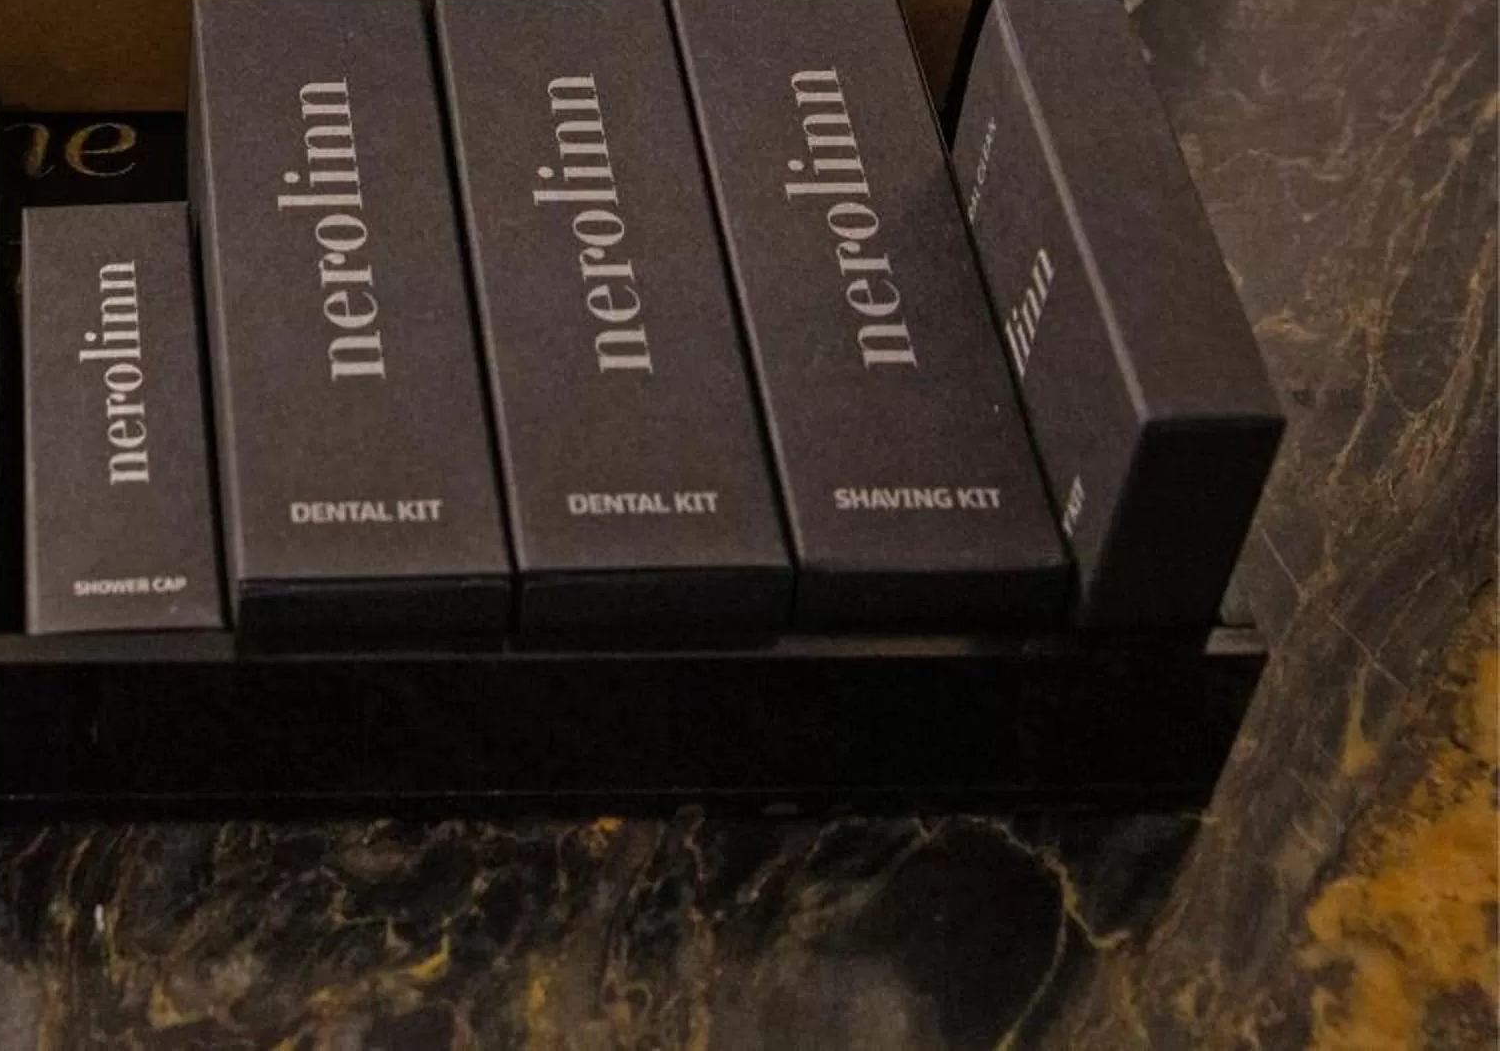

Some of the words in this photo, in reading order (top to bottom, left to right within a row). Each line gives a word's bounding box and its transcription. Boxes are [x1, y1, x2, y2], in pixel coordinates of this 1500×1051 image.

[277, 75, 387, 382] nerolinn
[531, 71, 654, 375] nerolinn
[784, 65, 918, 370] nerolinn
[78, 259, 150, 486] nerolinn
[289, 500, 393, 524] DENTAL
[396, 498, 443, 523] KIT
[566, 492, 671, 516] DENTAL
[673, 491, 718, 515] KIT
[833, 487, 954, 510] SHAVING
[955, 487, 1001, 510] KIT
[73, 578, 149, 597] SHOWER
[151, 575, 188, 594] CAP
